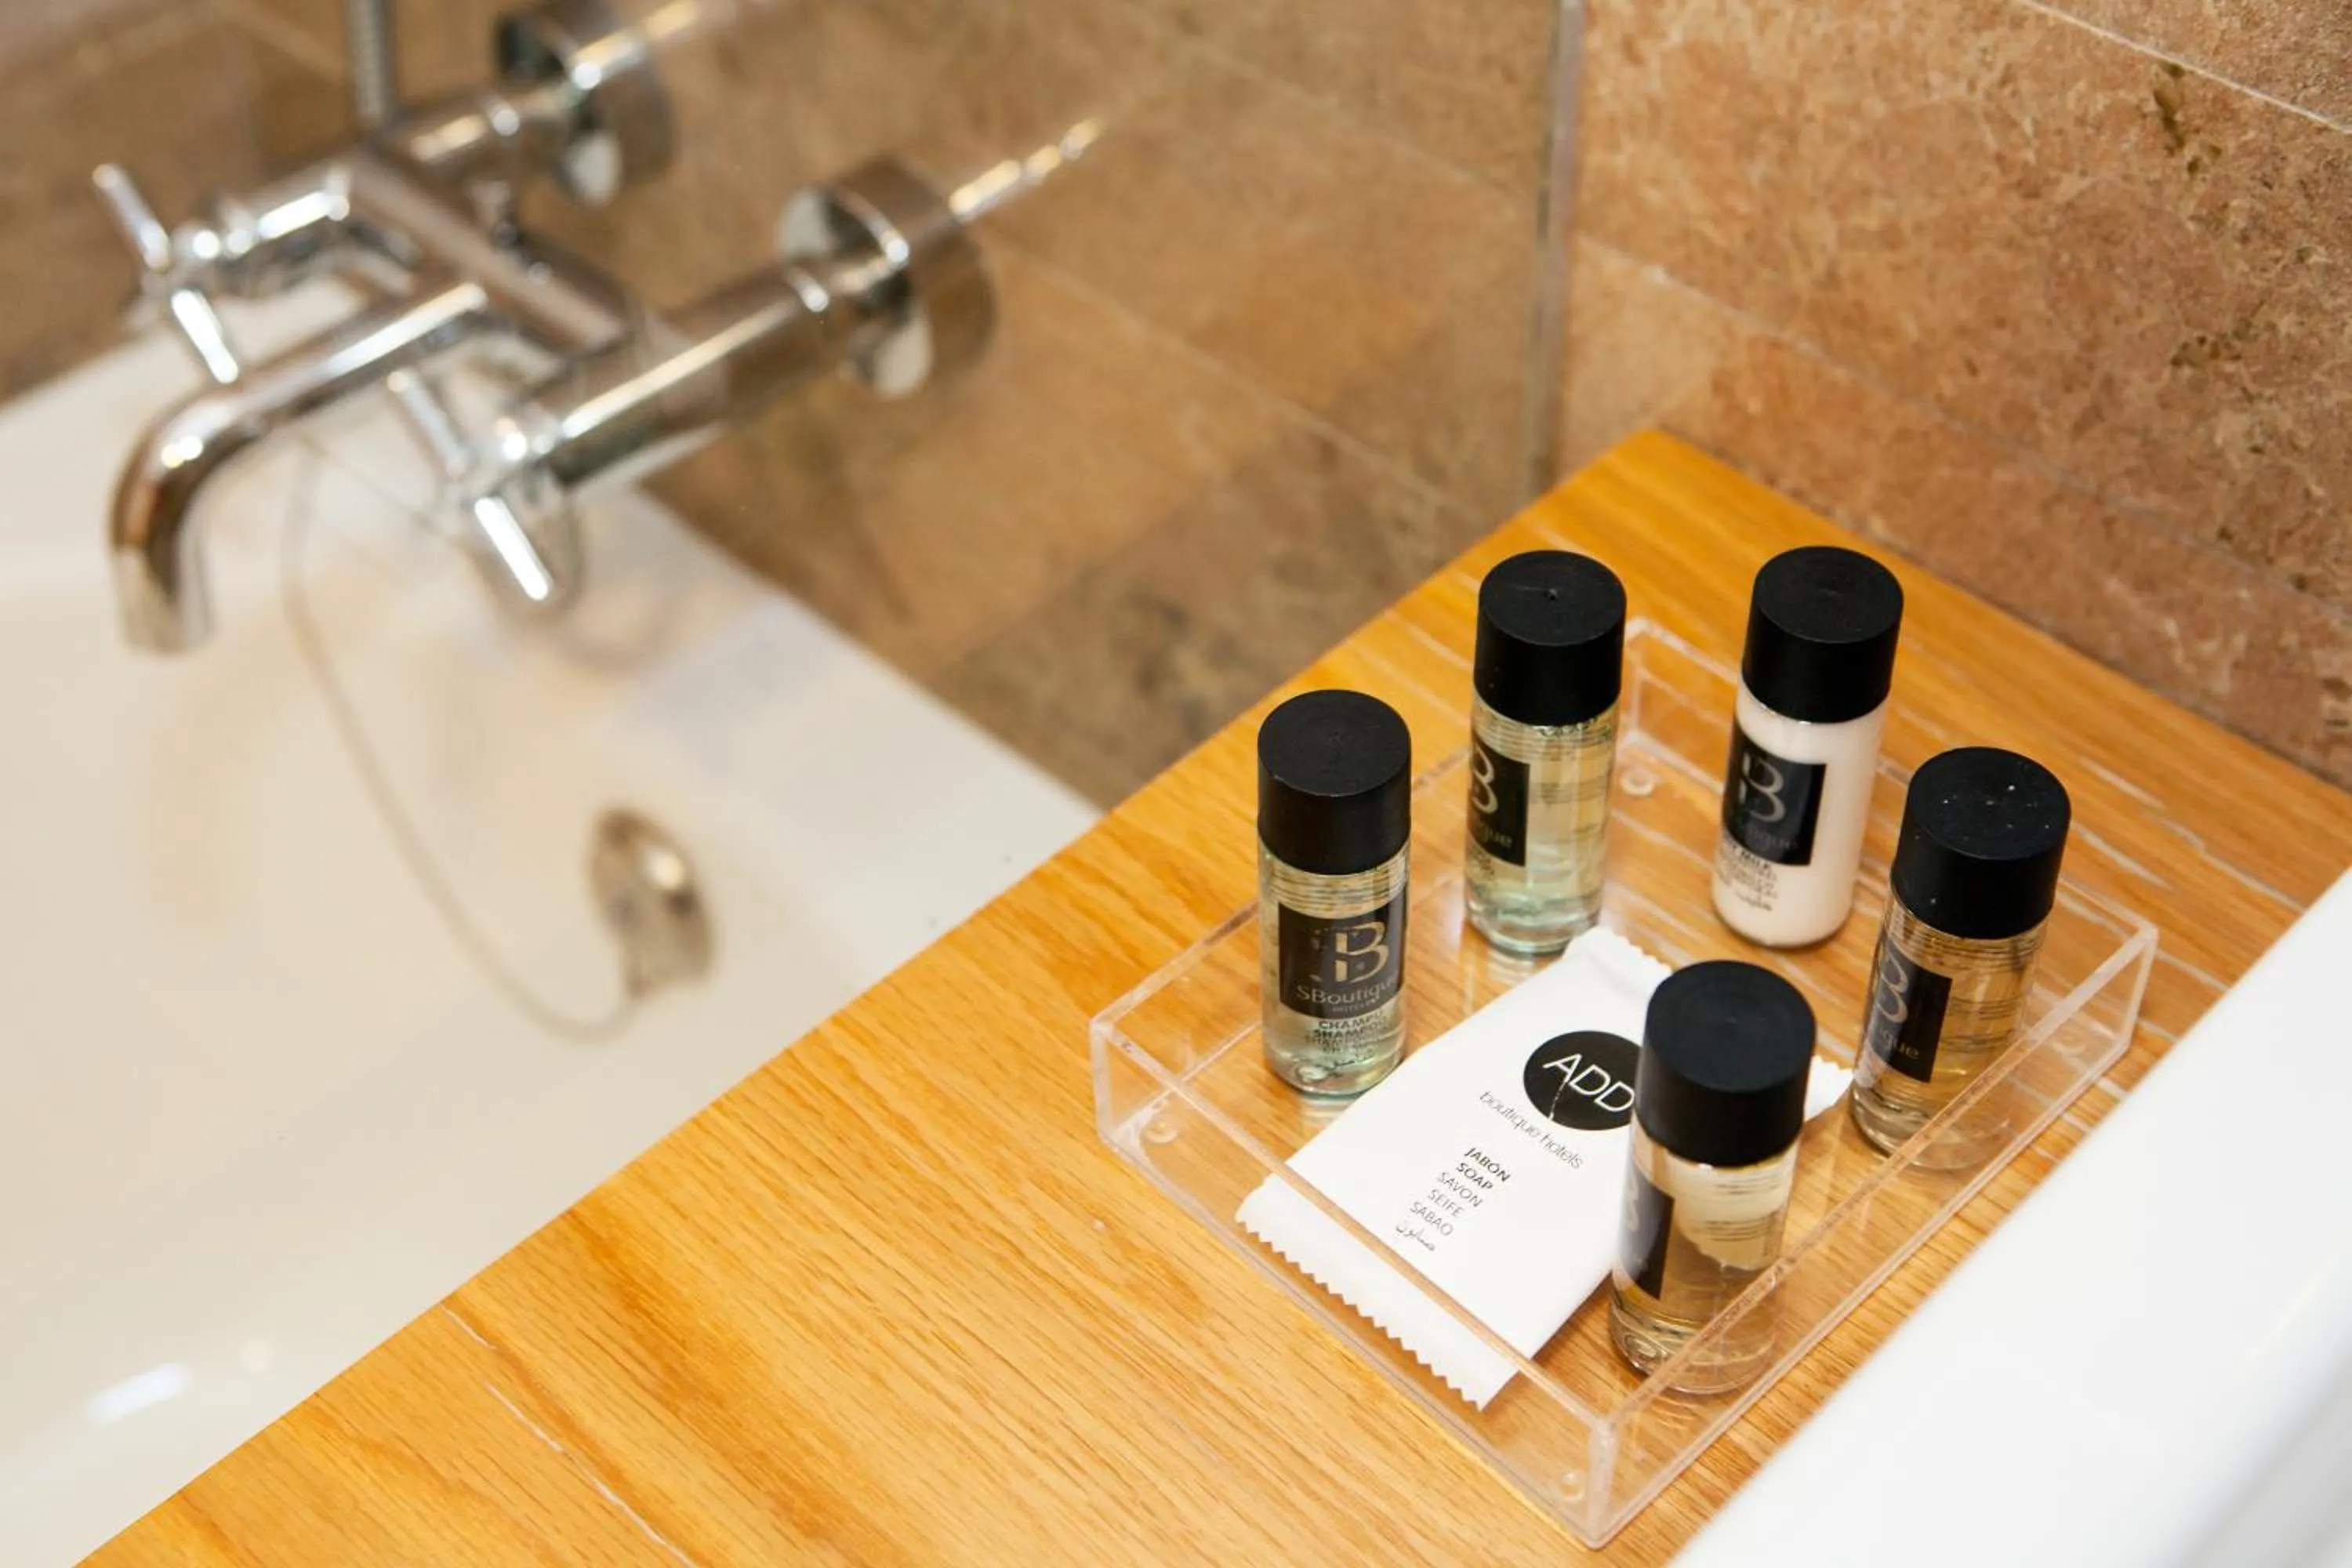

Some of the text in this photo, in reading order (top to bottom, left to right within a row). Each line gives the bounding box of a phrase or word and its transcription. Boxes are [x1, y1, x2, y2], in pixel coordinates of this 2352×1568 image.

[1541, 1053, 1636, 1112] ADD
[1479, 1091, 1584, 1170] boutique hotels
[1437, 1171, 1484, 1208] SAVON
[1456, 1162, 1494, 1190] SOAP
[1427, 1189, 1466, 1218] SEIFE
